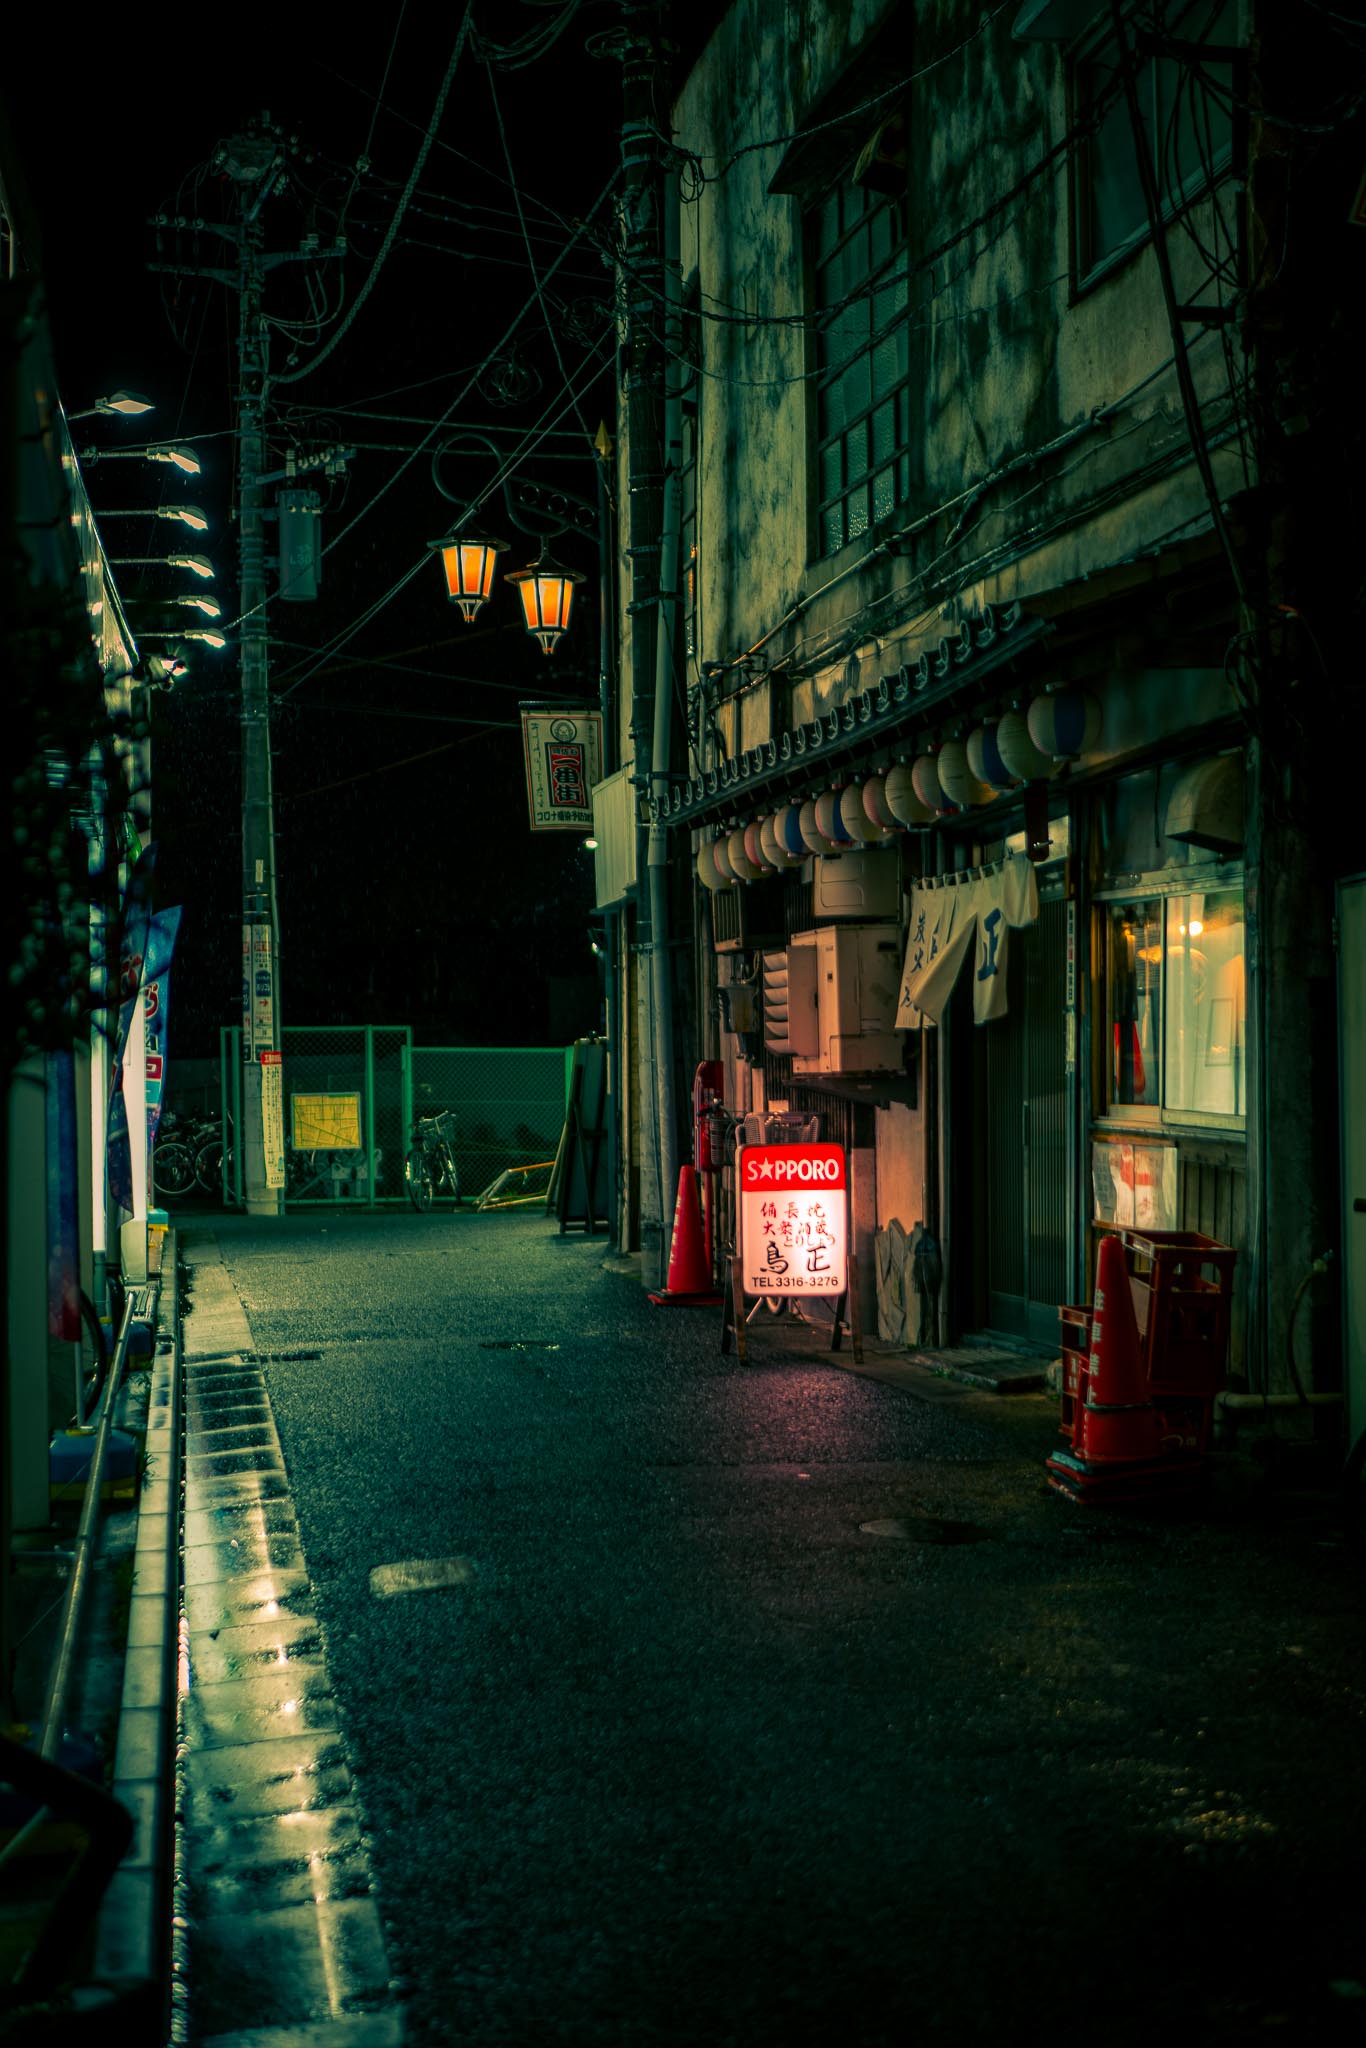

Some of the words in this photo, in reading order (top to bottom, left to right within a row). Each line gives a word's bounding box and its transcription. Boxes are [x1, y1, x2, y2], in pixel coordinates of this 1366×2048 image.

[552, 758, 580, 802] 一番街
[747, 1157, 839, 1181] SAPPORO
[759, 1240, 831, 1275] 鳥正
[752, 1277, 774, 1287] TEL
[776, 1276, 839, 1287] 3316-3276
